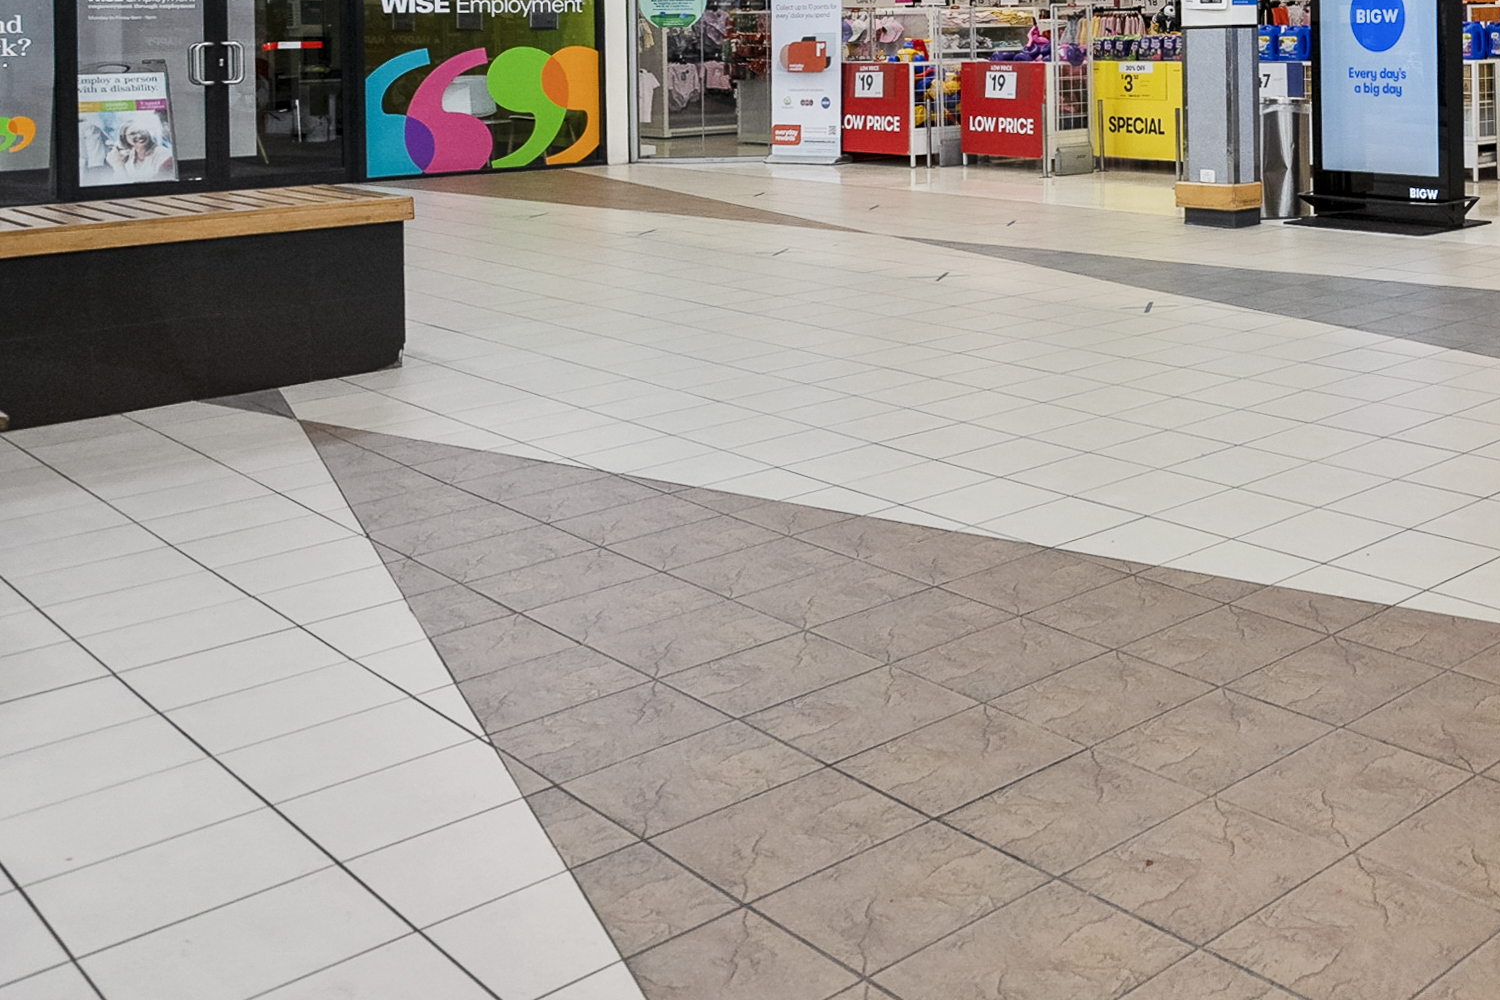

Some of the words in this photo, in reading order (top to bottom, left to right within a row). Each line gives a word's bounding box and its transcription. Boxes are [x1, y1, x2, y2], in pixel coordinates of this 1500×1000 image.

[1349, 67, 1377, 81] Every
[1380, 68, 1406, 81] day's
[110, 84, 158, 92] disability.
[1364, 82, 1380, 96] big
[1382, 83, 1402, 97] day
[842, 114, 865, 130] OW
[866, 115, 900, 132] PRICE
[969, 116, 996, 132] LOW
[998, 118, 1034, 135] PRICE
[1108, 116, 1165, 134] SPECIAL
